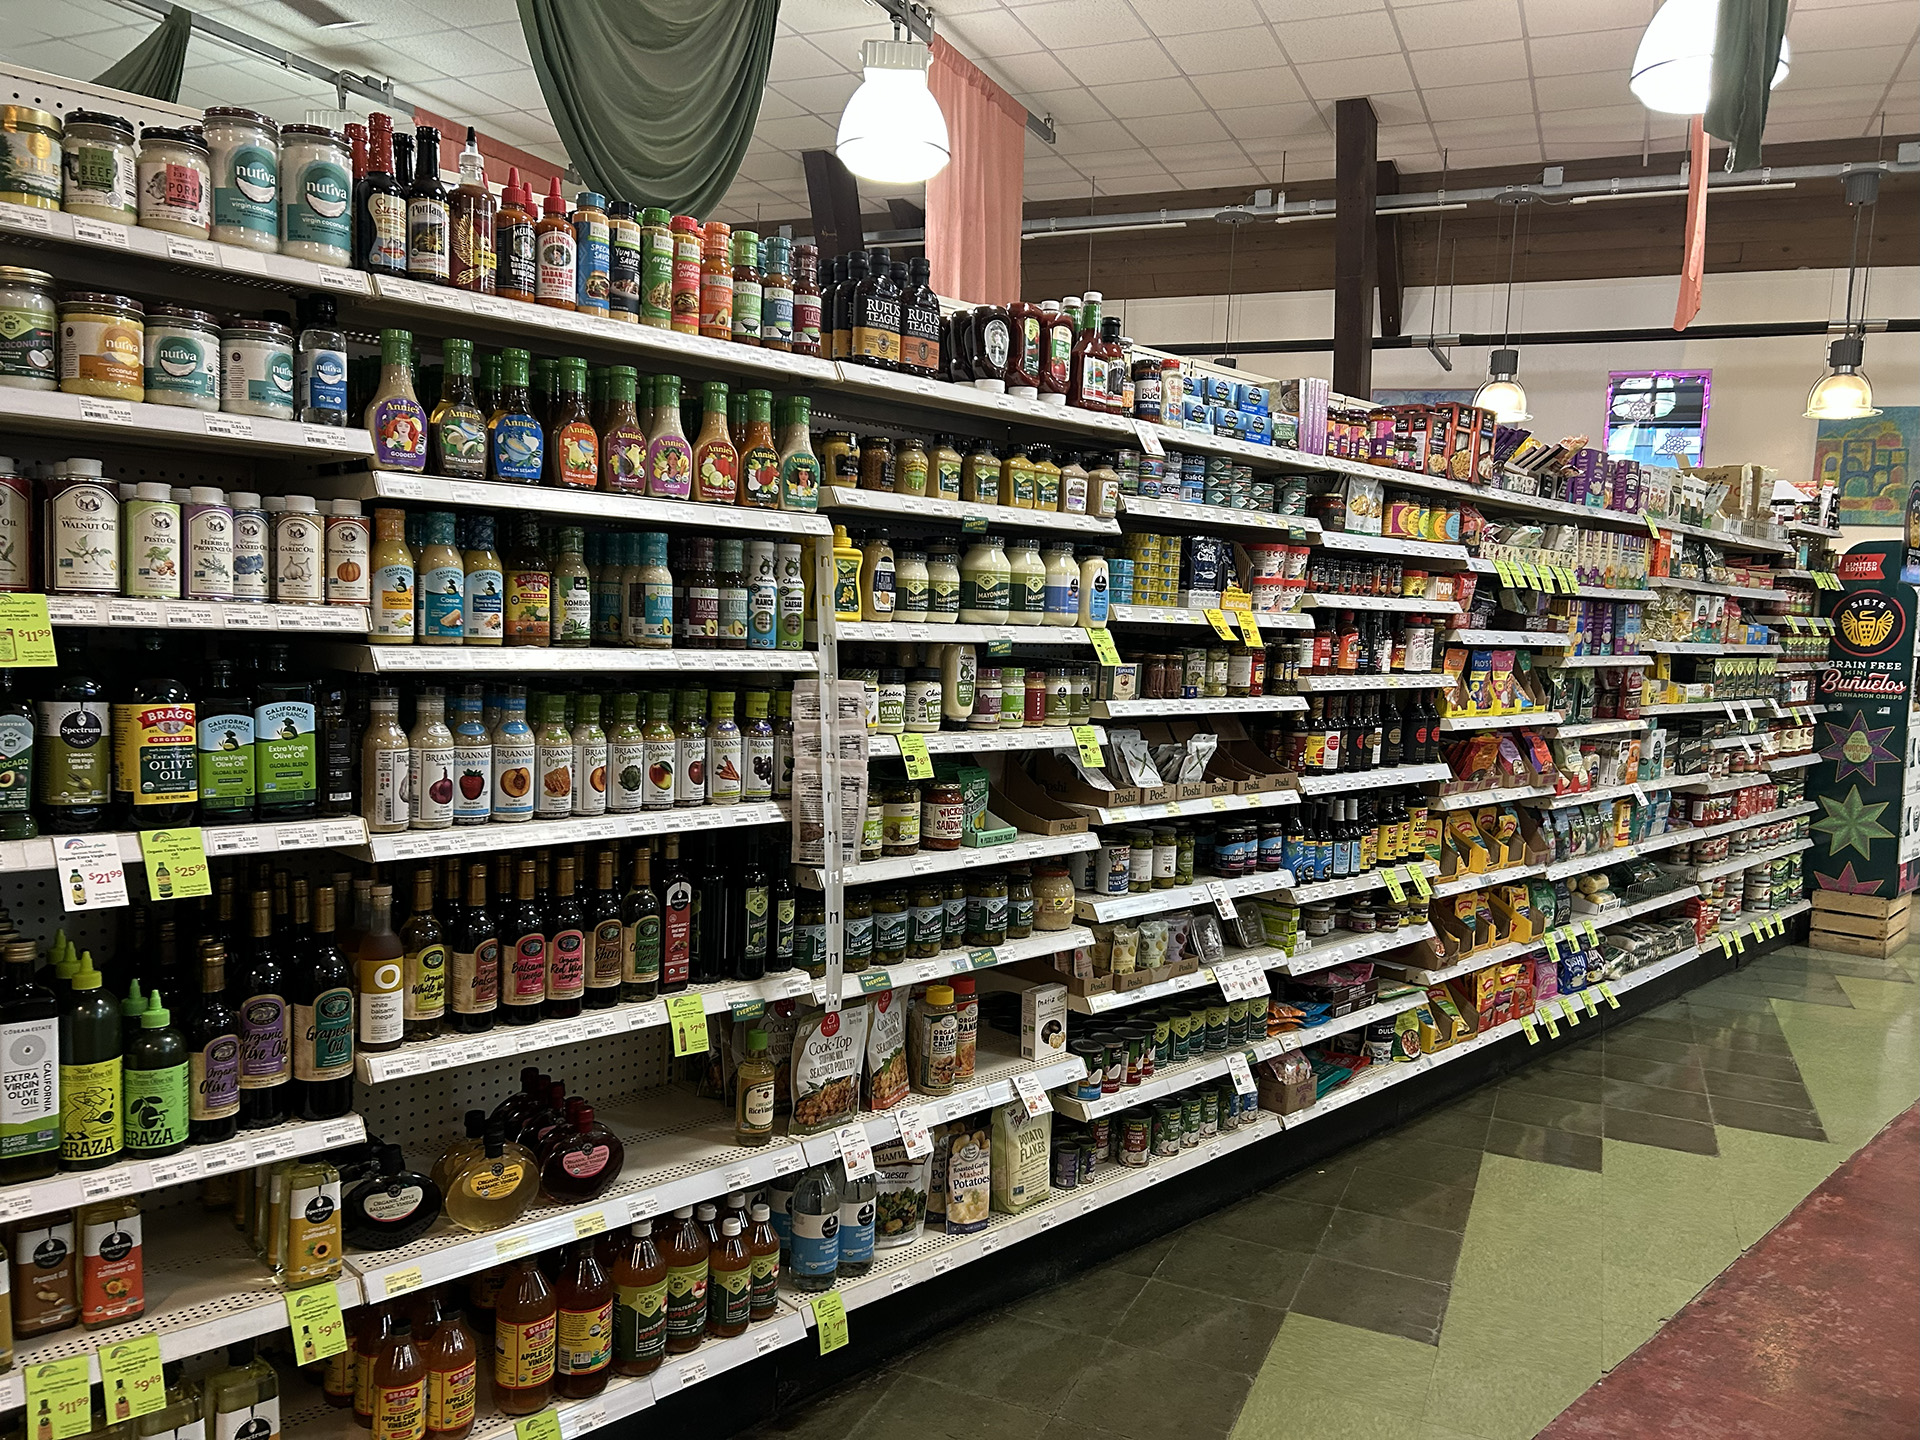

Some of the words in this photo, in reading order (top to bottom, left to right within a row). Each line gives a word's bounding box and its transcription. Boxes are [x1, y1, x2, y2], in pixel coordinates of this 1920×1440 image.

[81, 166, 112, 177] BEEF
[236, 165, 275, 185] nutiva
[168, 183, 197, 198] PORK
[307, 182, 346, 199] nutiva
[620, 257, 639, 265] SAUCE
[867, 298, 901, 317] RUFUS
[867, 311, 900, 327] TEAGUE
[908, 309, 940, 325] RUFUS
[908, 321, 940, 336] TEAGUE
[105, 338, 138, 352] nutiva
[160, 349, 197, 362] nutiva
[316, 363, 341, 373] nutiva
[386, 402, 420, 414] Annie's
[449, 409, 480, 421] Annie's
[503, 418, 537, 430] Annie's
[567, 425, 594, 436] Annie's
[615, 430, 642, 441] Annie's
[658, 438, 685, 448] Annie's
[707, 444, 733, 455] Annie's
[751, 450, 777, 460] Annie's
[790, 455, 816, 466] Annie's
[62, 521, 99, 529] WALNUT
[102, 523, 115, 531] OIL
[1200, 542, 1216, 553] Safe
[1197, 551, 1216, 562] Catch
[1437, 581, 1452, 594] TOFU
[755, 599, 773, 607] RANCH
[1851, 599, 1886, 609] SIETE
[991, 643, 1010, 652] EVERYDAY
[1829, 661, 1867, 669] GRAIN
[1870, 661, 1902, 670] FREE
[1821, 668, 1907, 694] Buñuelos
[147, 709, 193, 721] BRAGG
[265, 706, 309, 715] CALIFORNIA
[268, 713, 284, 721] OLIVE
[207, 720, 250, 729] CALIFORNIA
[268, 745, 287, 753] Extra
[288, 744, 309, 753] Virgin
[229, 754, 248, 762] Virgin
[272, 752, 292, 760] Olive
[294, 751, 305, 759] Oil
[149, 759, 194, 771] OLIVE
[269, 761, 291, 769] GLOBAL
[292, 760, 309, 768] BLEND
[454, 759, 475, 767] SUGAR
[159, 771, 186, 781] OIL
[1211, 784, 1228, 793] Poshi
[1244, 781, 1260, 791] Poshi
[1275, 779, 1290, 787] Poshi
[1182, 785, 1200, 796] Poshi
[1113, 791, 1136, 804] Poshi
[1060, 822, 1077, 832] Poshi
[880, 927, 901, 937] KOSHER
[551, 963, 567, 973] Red
[1178, 963, 1193, 972] Poshi
[1565, 955, 1586, 971] SUSHI
[865, 976, 886, 987] EVERYDAY
[1090, 981, 1107, 991] Poshi
[1127, 976, 1143, 987] Poshi
[371, 1007, 396, 1015] balsamic
[736, 1003, 762, 1016] EVERYDAY
[271, 1038, 288, 1057] Oil
[328, 1039, 344, 1053] Oil
[819, 1054, 835, 1064] STUFFING
[810, 1064, 833, 1079] SEASONED
[834, 1059, 855, 1072] POULTRY
[3, 1072, 39, 1083] EXTRA
[4, 1080, 39, 1091] VIRGIN
[44, 1063, 52, 1112] CALIFORNIA
[200, 1078, 226, 1094] Olive
[8, 1089, 39, 1100] OLIVE
[21, 1097, 39, 1106] OIL
[749, 1106, 761, 1114] Rice
[2, 1134, 28, 1142] CLASSIC
[1018, 1129, 1043, 1145] POTATO
[2, 1140, 27, 1148] FLAVOR
[60, 1136, 115, 1158] GRAZA
[1020, 1142, 1046, 1162] FLAKES
[972, 1162, 988, 1170] Garlic
[477, 1177, 499, 1186] ORGANIC
[501, 1171, 517, 1181] CITRUS
[880, 1170, 908, 1180] Caesar
[959, 1169, 984, 1179] Mashed
[953, 1175, 990, 1189] Potatoes
[520, 1349, 541, 1360] APPLE
[387, 1418, 415, 1428] VINEGAR
